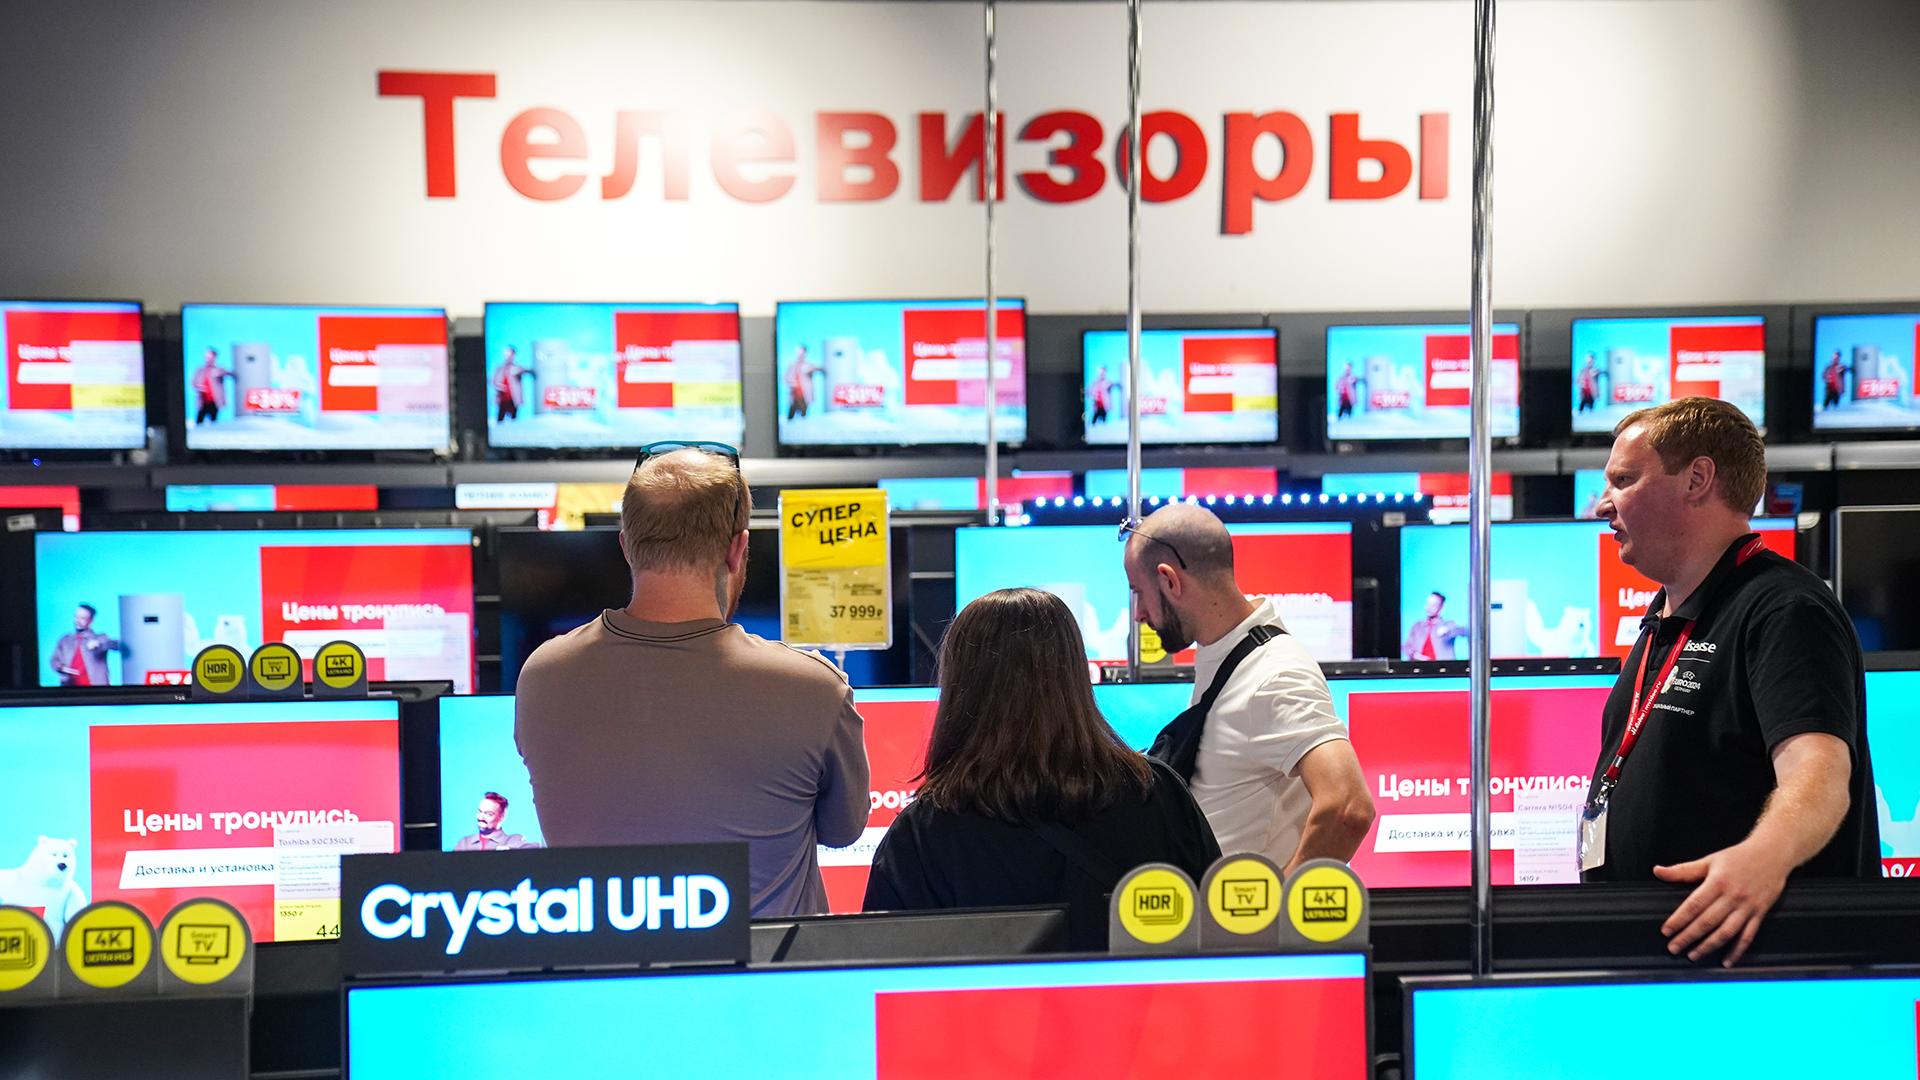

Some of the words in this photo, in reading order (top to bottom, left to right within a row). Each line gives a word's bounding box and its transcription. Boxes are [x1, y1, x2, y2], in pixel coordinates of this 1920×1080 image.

[377, 69, 1450, 235] Телевизоры
[791, 502, 861, 528] СУПЕР
[819, 521, 878, 546] ЦЕНА
[282, 601, 338, 624] Цены
[207, 663, 228, 674] HDR
[332, 657, 348, 667] 4K
[1378, 773, 1450, 801] Цены
[124, 808, 203, 836] Цены
[209, 808, 360, 835] тронулись
[279, 838, 310, 847] Toshiba
[1388, 828, 1443, 841] Доставка
[135, 864, 195, 877] Доставка
[199, 865, 207, 874] и
[210, 862, 275, 876] установка
[1139, 894, 1171, 911] HDR
[1236, 894, 1255, 905] TV
[1313, 891, 1337, 905] 4K
[360, 877, 594, 955] Crystal
[606, 874, 730, 932] UHD
[94, 931, 123, 948] 4K
[193, 940, 216, 952] TV
